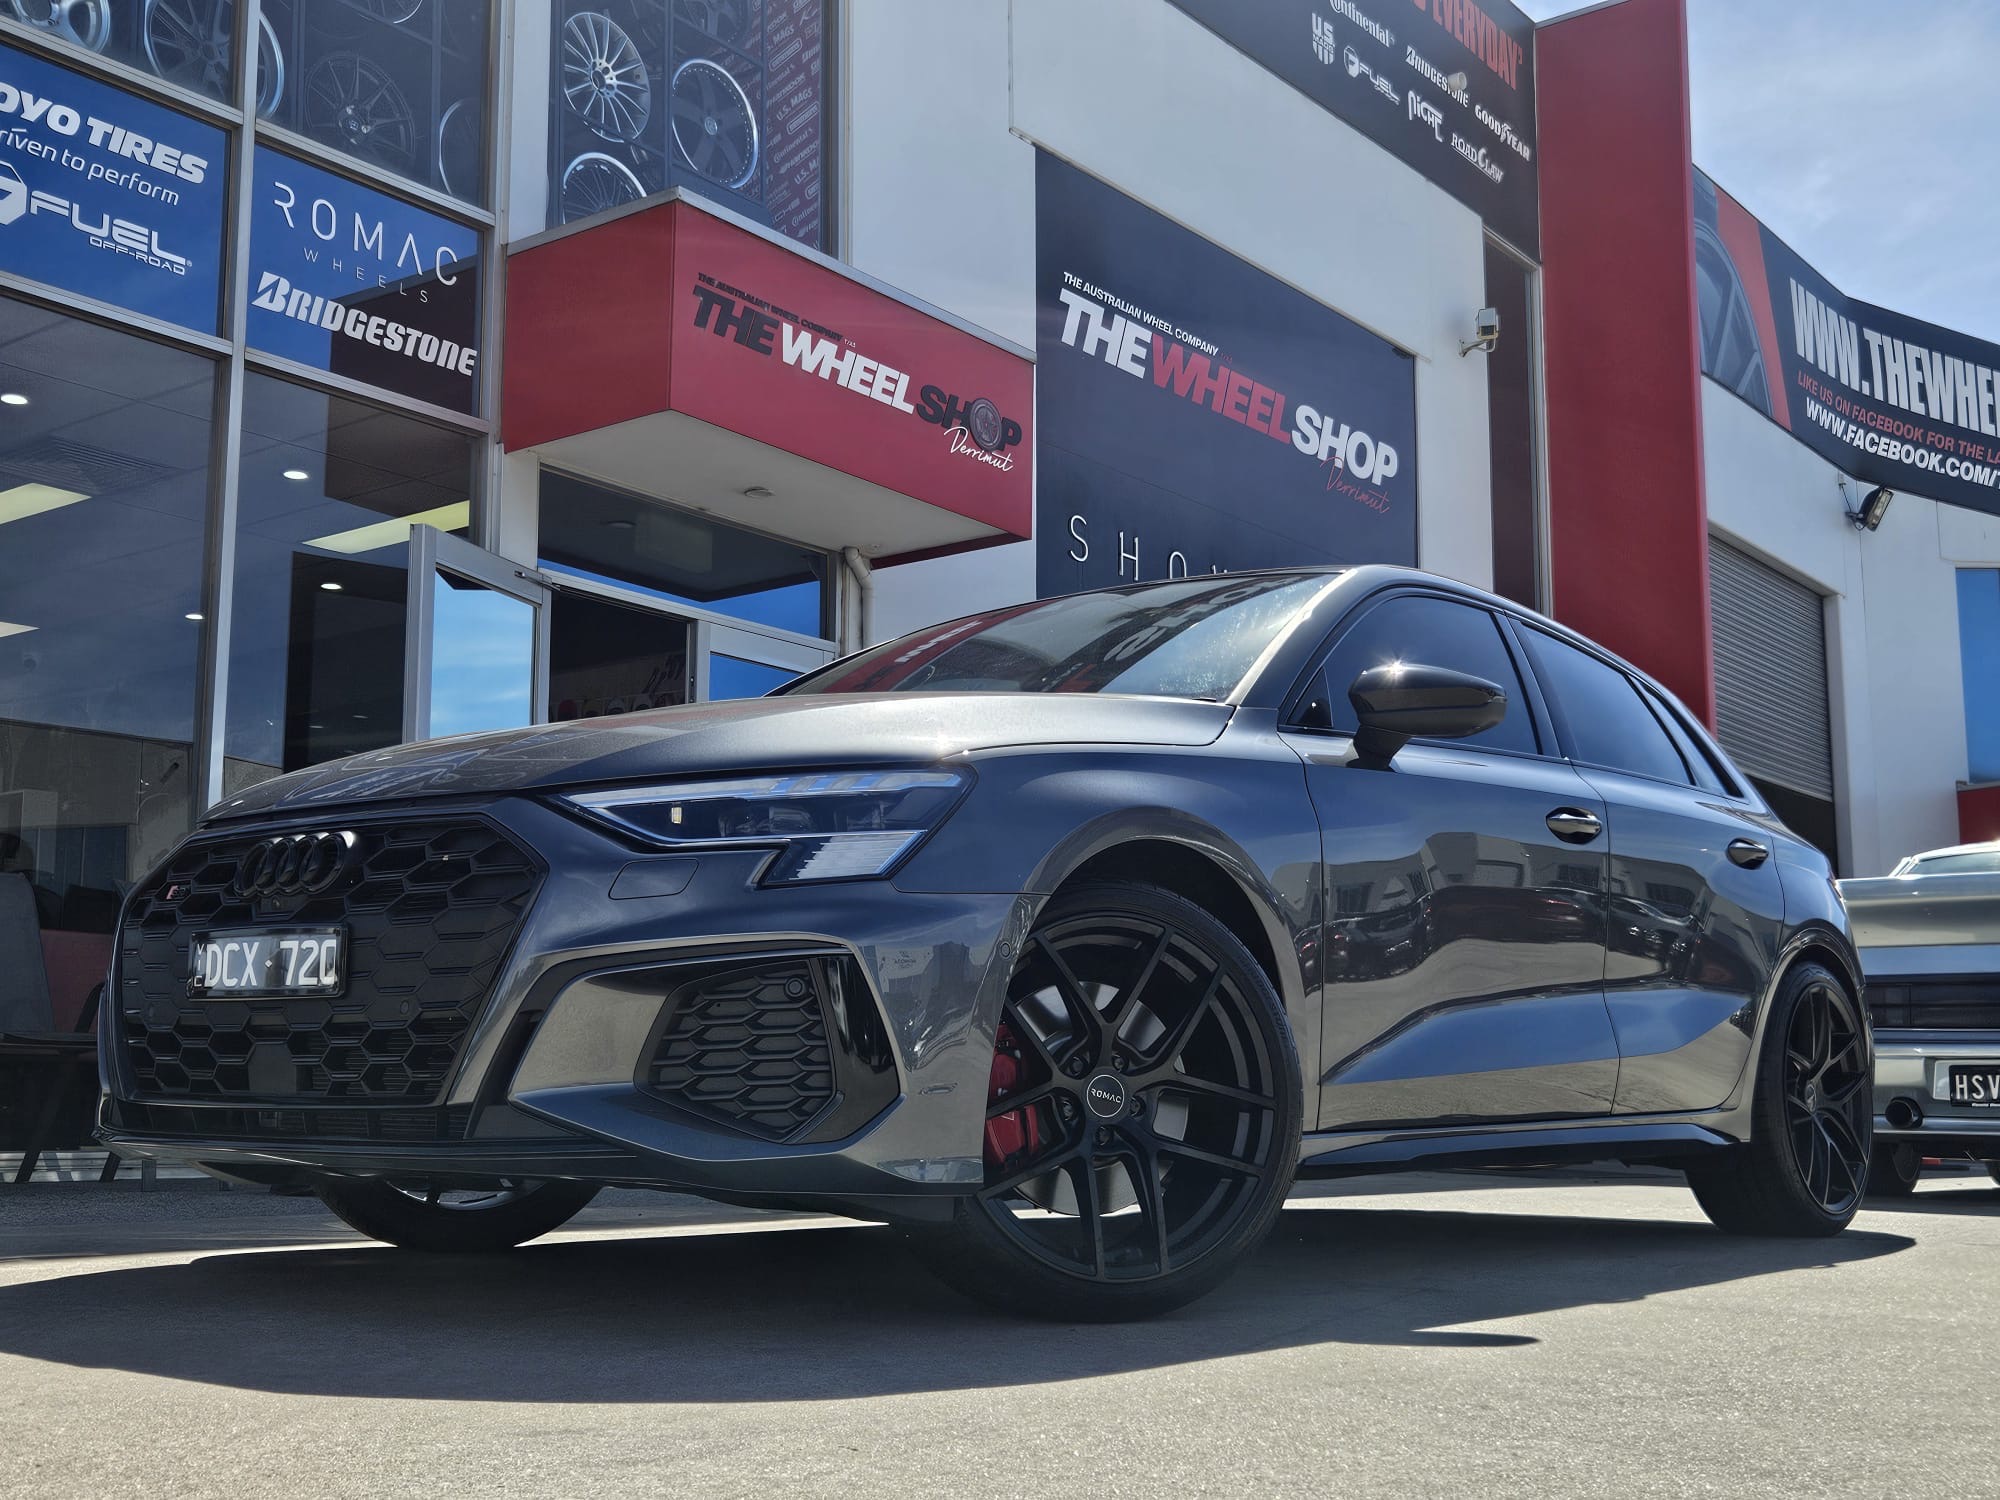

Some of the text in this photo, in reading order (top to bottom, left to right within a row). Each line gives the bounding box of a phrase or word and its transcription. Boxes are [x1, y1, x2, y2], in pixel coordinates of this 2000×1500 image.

[87, 116, 208, 184] TIRES
[1474, 104, 1531, 163] GOODYEAR
[61, 149, 86, 171] to
[87, 163, 179, 206] perform
[30, 190, 186, 266] FUEL
[89, 236, 185, 276] OFF-ROAD
[273, 181, 459, 286] ROMAC
[303, 247, 429, 303] WHEELS
[251, 271, 478, 377] BRIDGESTONE
[1064, 271, 1083, 290] THE
[1083, 282, 1142, 319] AUSTRALIAN
[1143, 312, 1174, 336] WHEEL
[1175, 328, 1219, 357] COMPANY
[693, 284, 780, 356] THE
[782, 322, 915, 414] WHEEL
[1060, 287, 1398, 485] THE WHEEL SHOP
[1797, 370, 1818, 396] LIKE
[1820, 385, 1833, 406] US
[1835, 395, 1851, 417] ON
[1852, 405, 1924, 443] FACEBOOK
[1926, 431, 1955, 452] FOR
[1958, 440, 1984, 460] THE
[944, 426, 1014, 472] Derrimut
[204, 942, 260, 987] DCX
[1091, 1088, 1122, 1103] ROMAC
